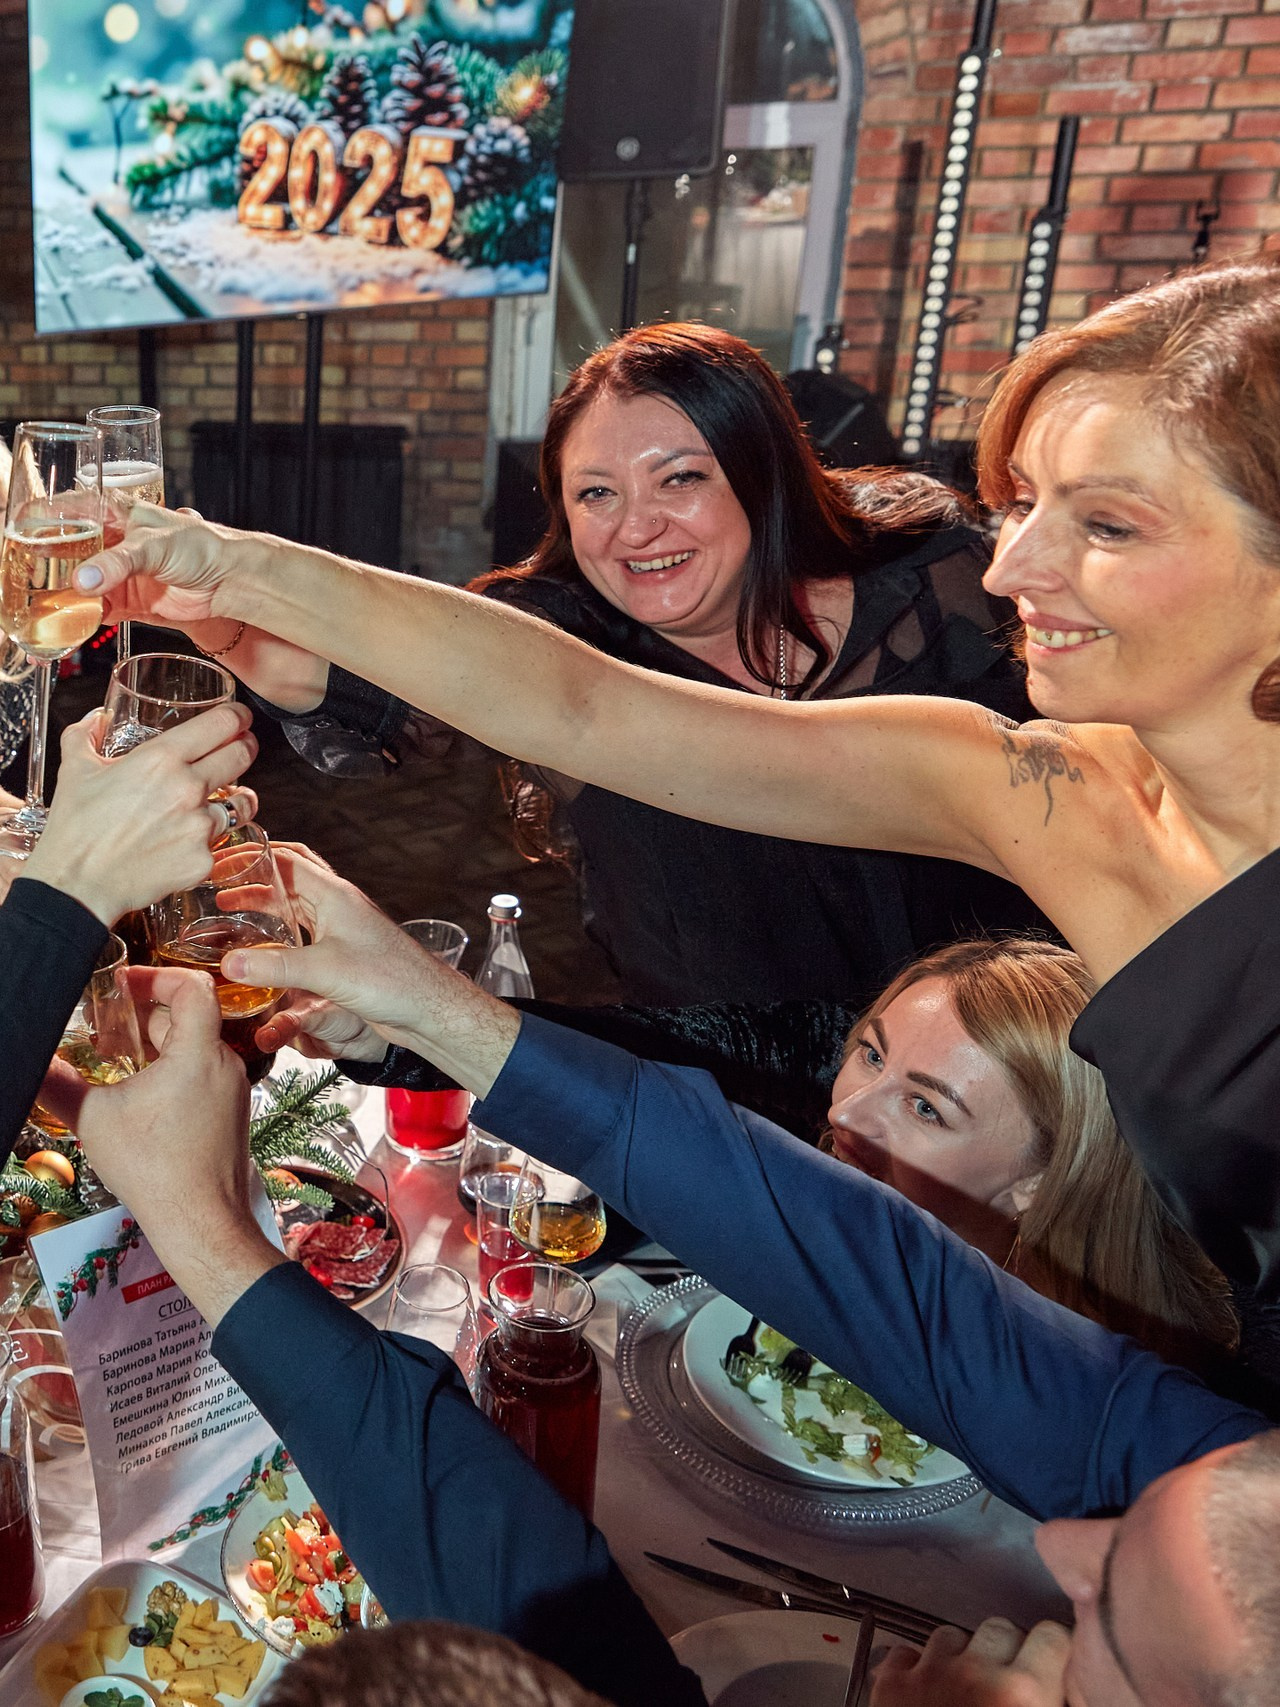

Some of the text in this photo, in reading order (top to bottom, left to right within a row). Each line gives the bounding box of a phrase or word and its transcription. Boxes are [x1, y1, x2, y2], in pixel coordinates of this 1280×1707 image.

[237, 119, 456, 250] 2025
[138, 1278, 161, 1294] ПЛАН
[158, 1296, 192, 1317] СТОЛ
[99, 1321, 196, 1365] Баринова Татьяна
[103, 1330, 214, 1381] Баринова Мария Ал
[106, 1373, 153, 1397] Карпова
[157, 1356, 191, 1377] Мария
[110, 1392, 143, 1413] Исаев
[145, 1373, 190, 1398] Виталий
[113, 1375, 233, 1428] Емешкина Юлия Миха
[116, 1416, 163, 1444] Ледовой
[167, 1393, 223, 1422] Александр
[119, 1432, 167, 1459] Минаков
[171, 1418, 202, 1436] Павел
[121, 1410, 261, 1474] Грива Евгений Владимиро
